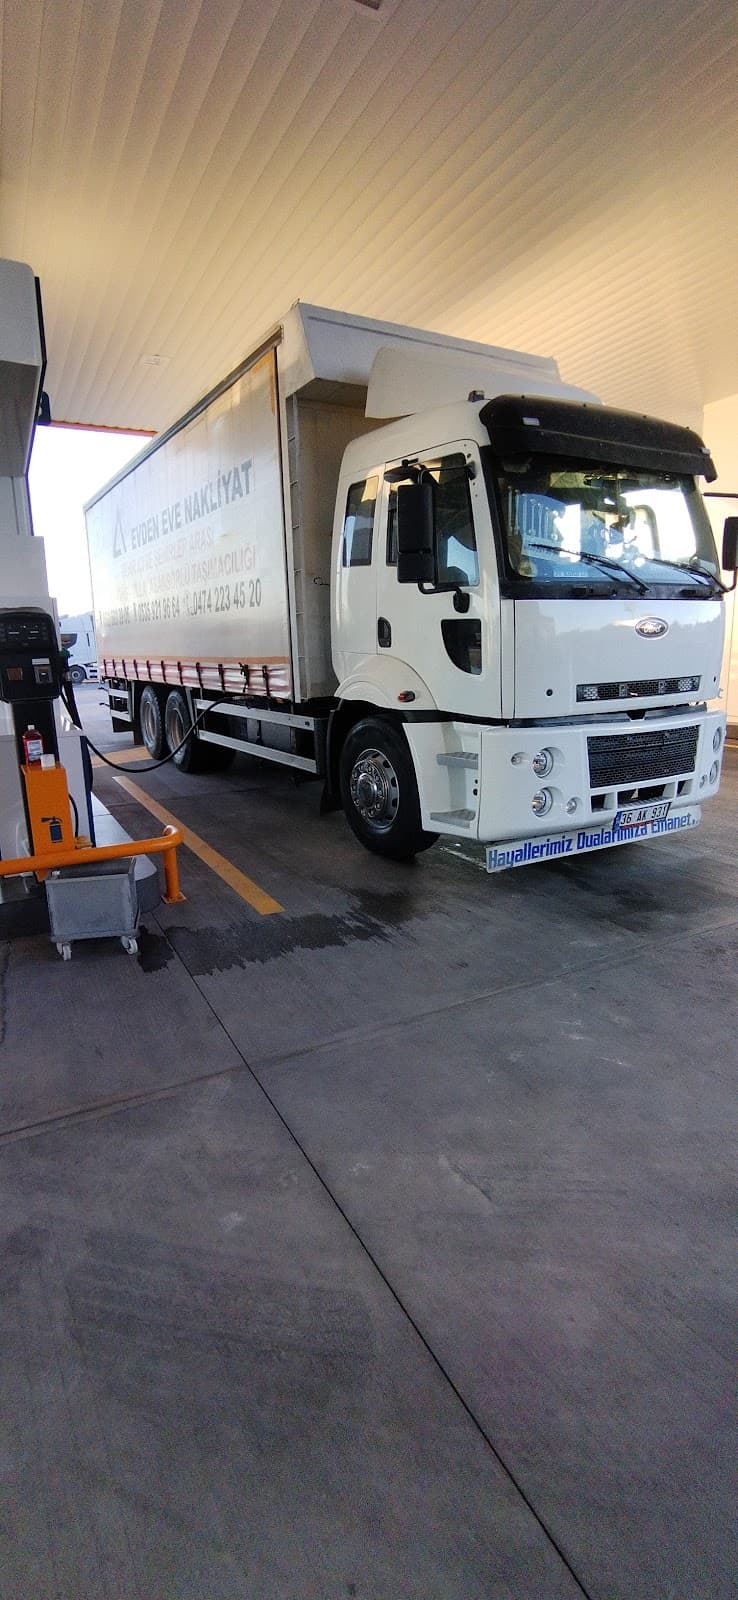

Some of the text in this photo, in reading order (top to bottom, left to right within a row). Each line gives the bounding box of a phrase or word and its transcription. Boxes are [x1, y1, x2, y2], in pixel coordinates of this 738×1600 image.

[132, 460, 253, 550] EVDEN EVE NAKLİYAT
[172, 595, 180, 618] 64
[193, 587, 212, 616] 0474
[214, 584, 231, 613] 223
[233, 580, 246, 609] 45
[249, 577, 262, 608] 20
[620, 804, 668, 825] 36 AK 931
[488, 835, 573, 870] Hayallerimiz
